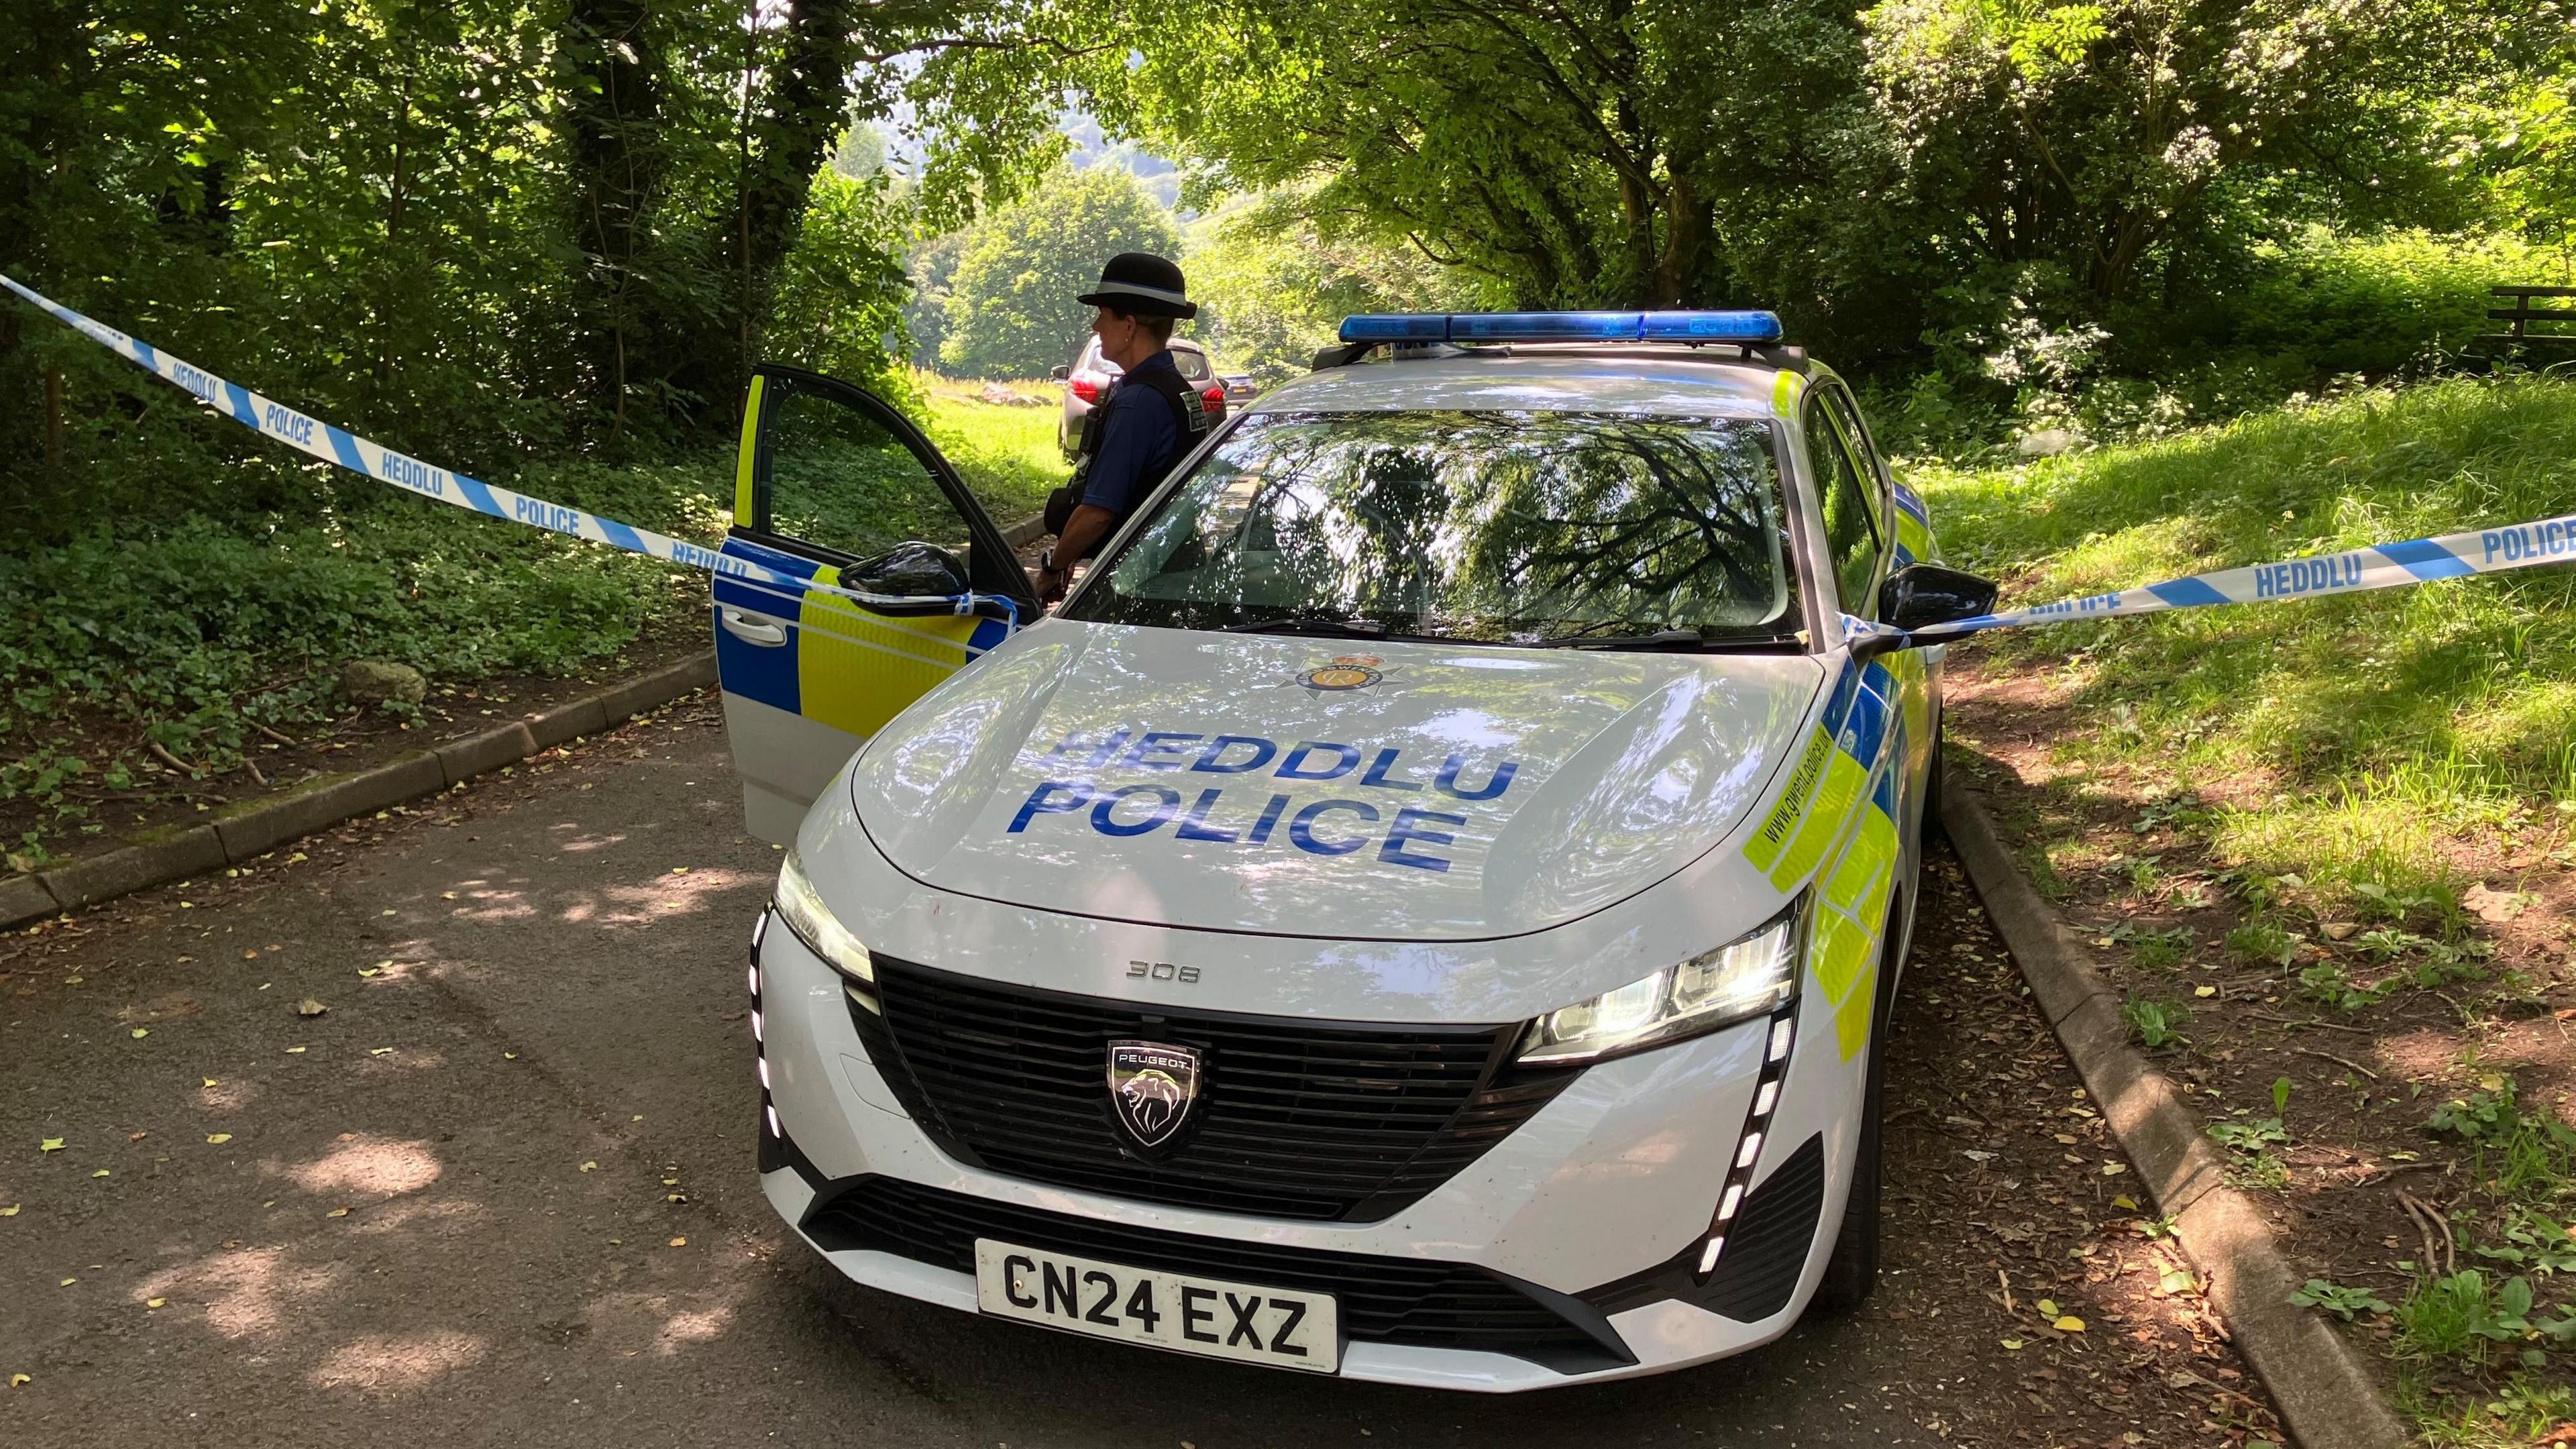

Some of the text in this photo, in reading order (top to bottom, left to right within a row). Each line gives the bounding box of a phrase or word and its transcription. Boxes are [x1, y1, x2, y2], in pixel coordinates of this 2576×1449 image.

[172, 363, 217, 402] HEDDLU
[266, 405, 313, 446] POLICE
[382, 452, 443, 496] HEDDLU
[516, 496, 579, 535] POLICE
[2254, 553, 2362, 598] HEDDLU
[2481, 519, 2576, 564] POLICE
[1032, 731, 1519, 801] HEDDLU
[1764, 727, 1831, 844] www.gwent.police.uk
[1006, 782, 1468, 873] POLICE
[1126, 960, 1201, 984] 308
[1119, 1054, 1188, 1069] PEUGEOT
[1004, 1253, 1307, 1357] CN24 EXZ
